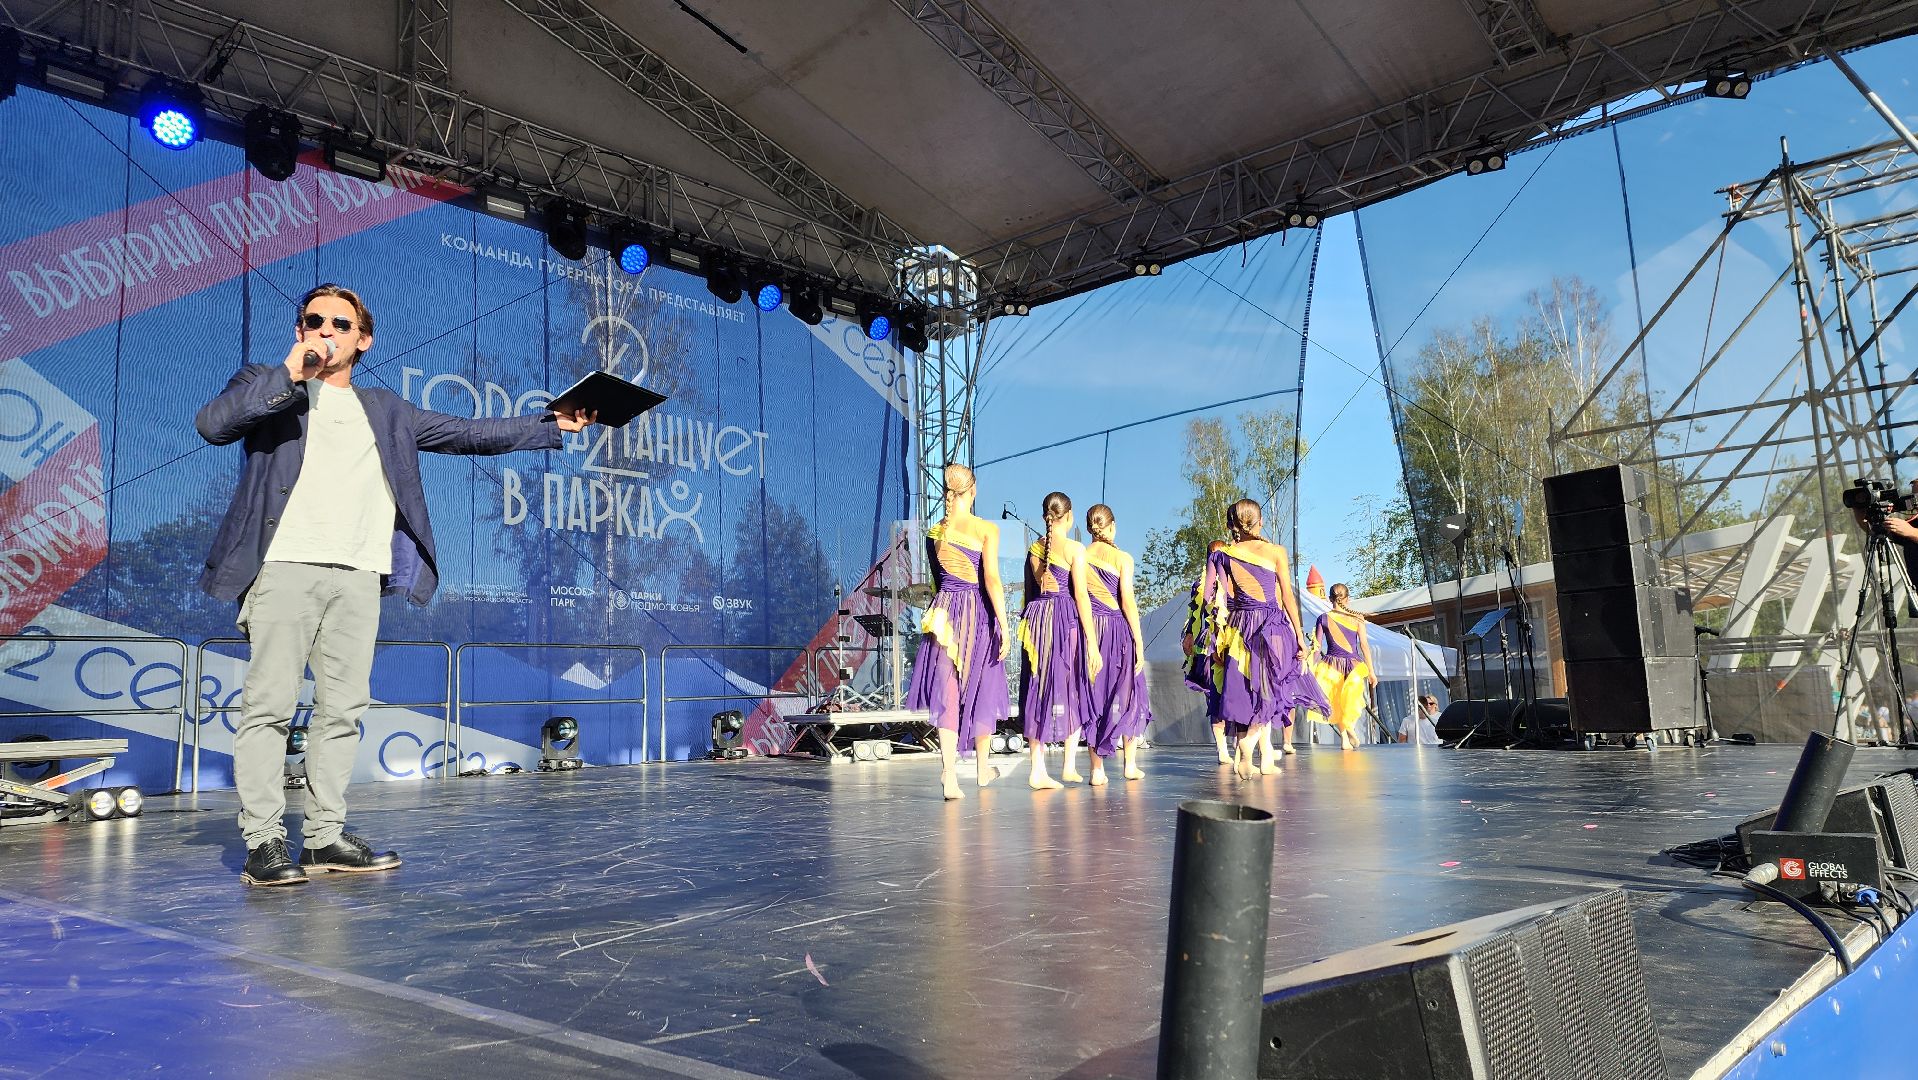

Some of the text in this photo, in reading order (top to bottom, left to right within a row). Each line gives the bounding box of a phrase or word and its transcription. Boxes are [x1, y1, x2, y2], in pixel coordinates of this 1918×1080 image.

[7, 207, 214, 319] ВЫБИРАЙ
[208, 177, 319, 249] ПАРК!
[441, 234, 746, 323] КОМАНДА ГУБЕРНАТОРА ПРЕДСТАВЛЯЕТ
[503, 467, 528, 525] В
[631, 591, 662, 600] ПАРКИ
[551, 598, 576, 608] ПАРК
[726, 598, 753, 610] ЗВУК
[4, 625, 56, 682] 2
[1808, 861, 1847, 871] GLOBAL
[1809, 869, 1848, 879] EFFECTS
